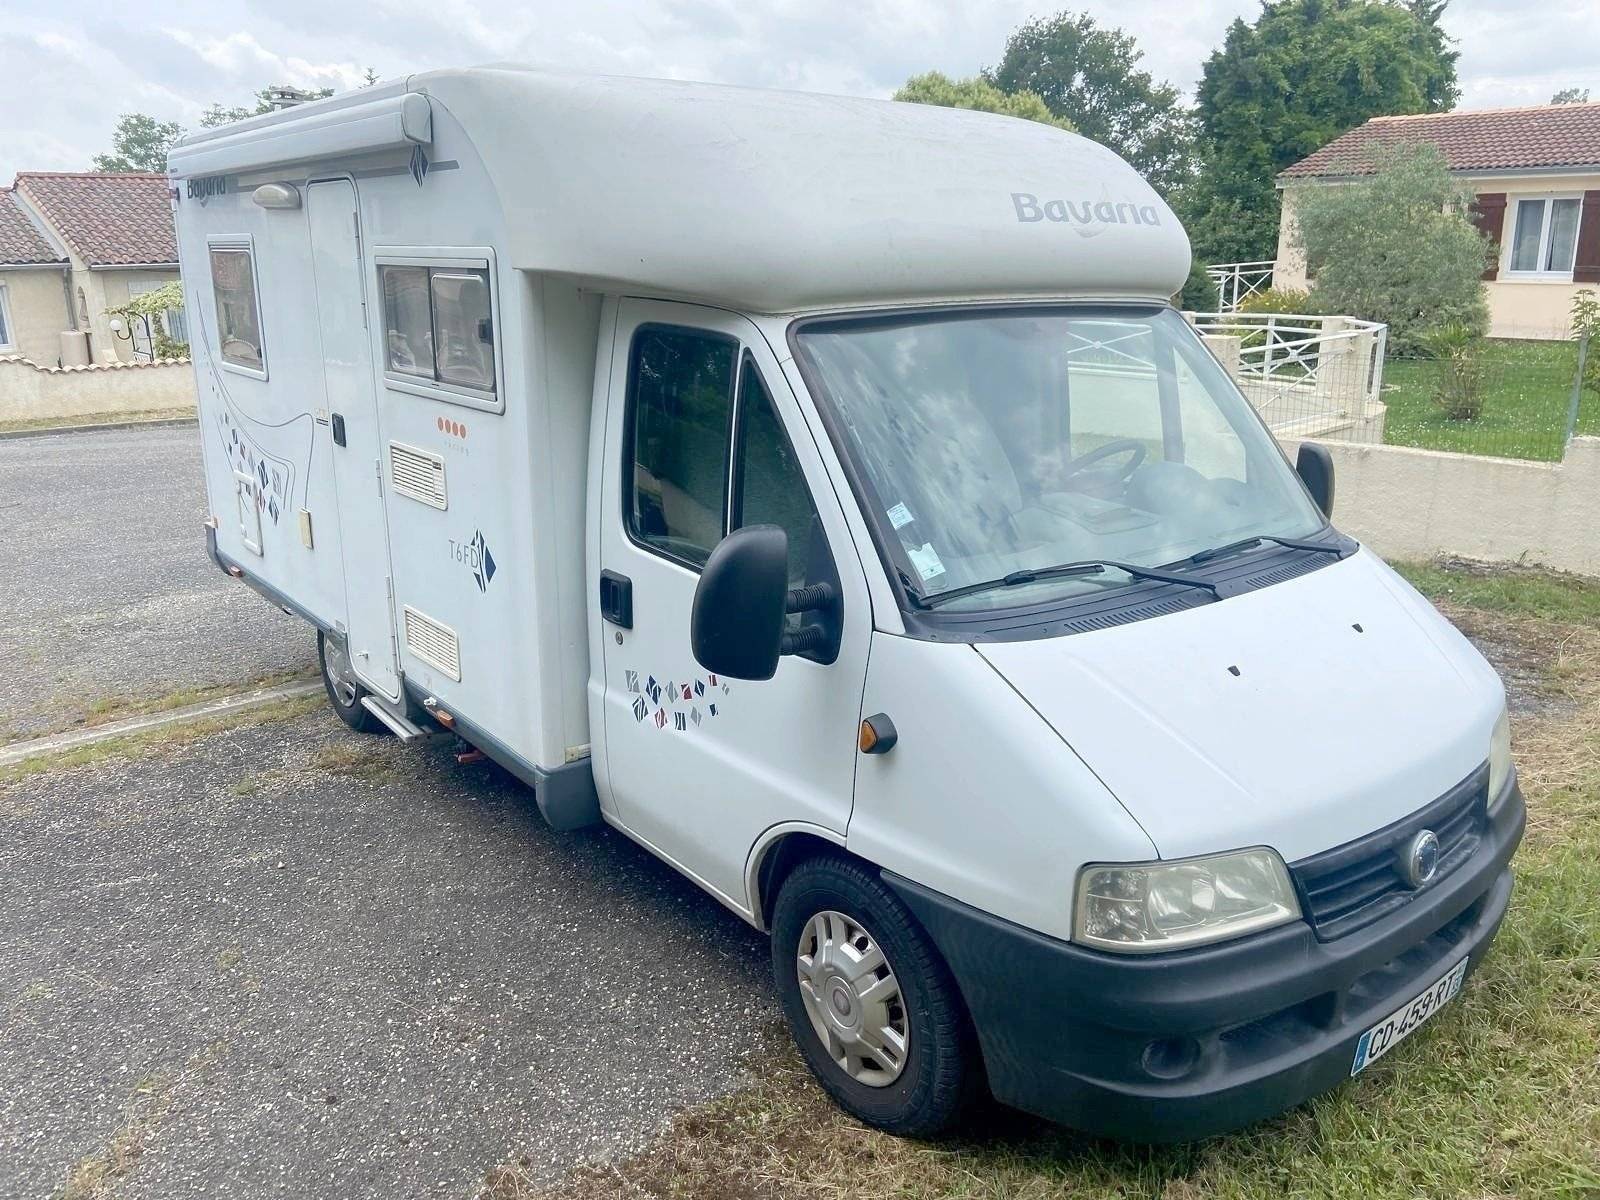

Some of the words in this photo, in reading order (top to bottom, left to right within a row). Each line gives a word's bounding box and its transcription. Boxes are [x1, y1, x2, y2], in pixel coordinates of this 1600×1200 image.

[1010, 192, 1162, 227] Bavaria
[448, 539, 479, 568] T6FD
[1368, 971, 1458, 1059] CD-459-RT
